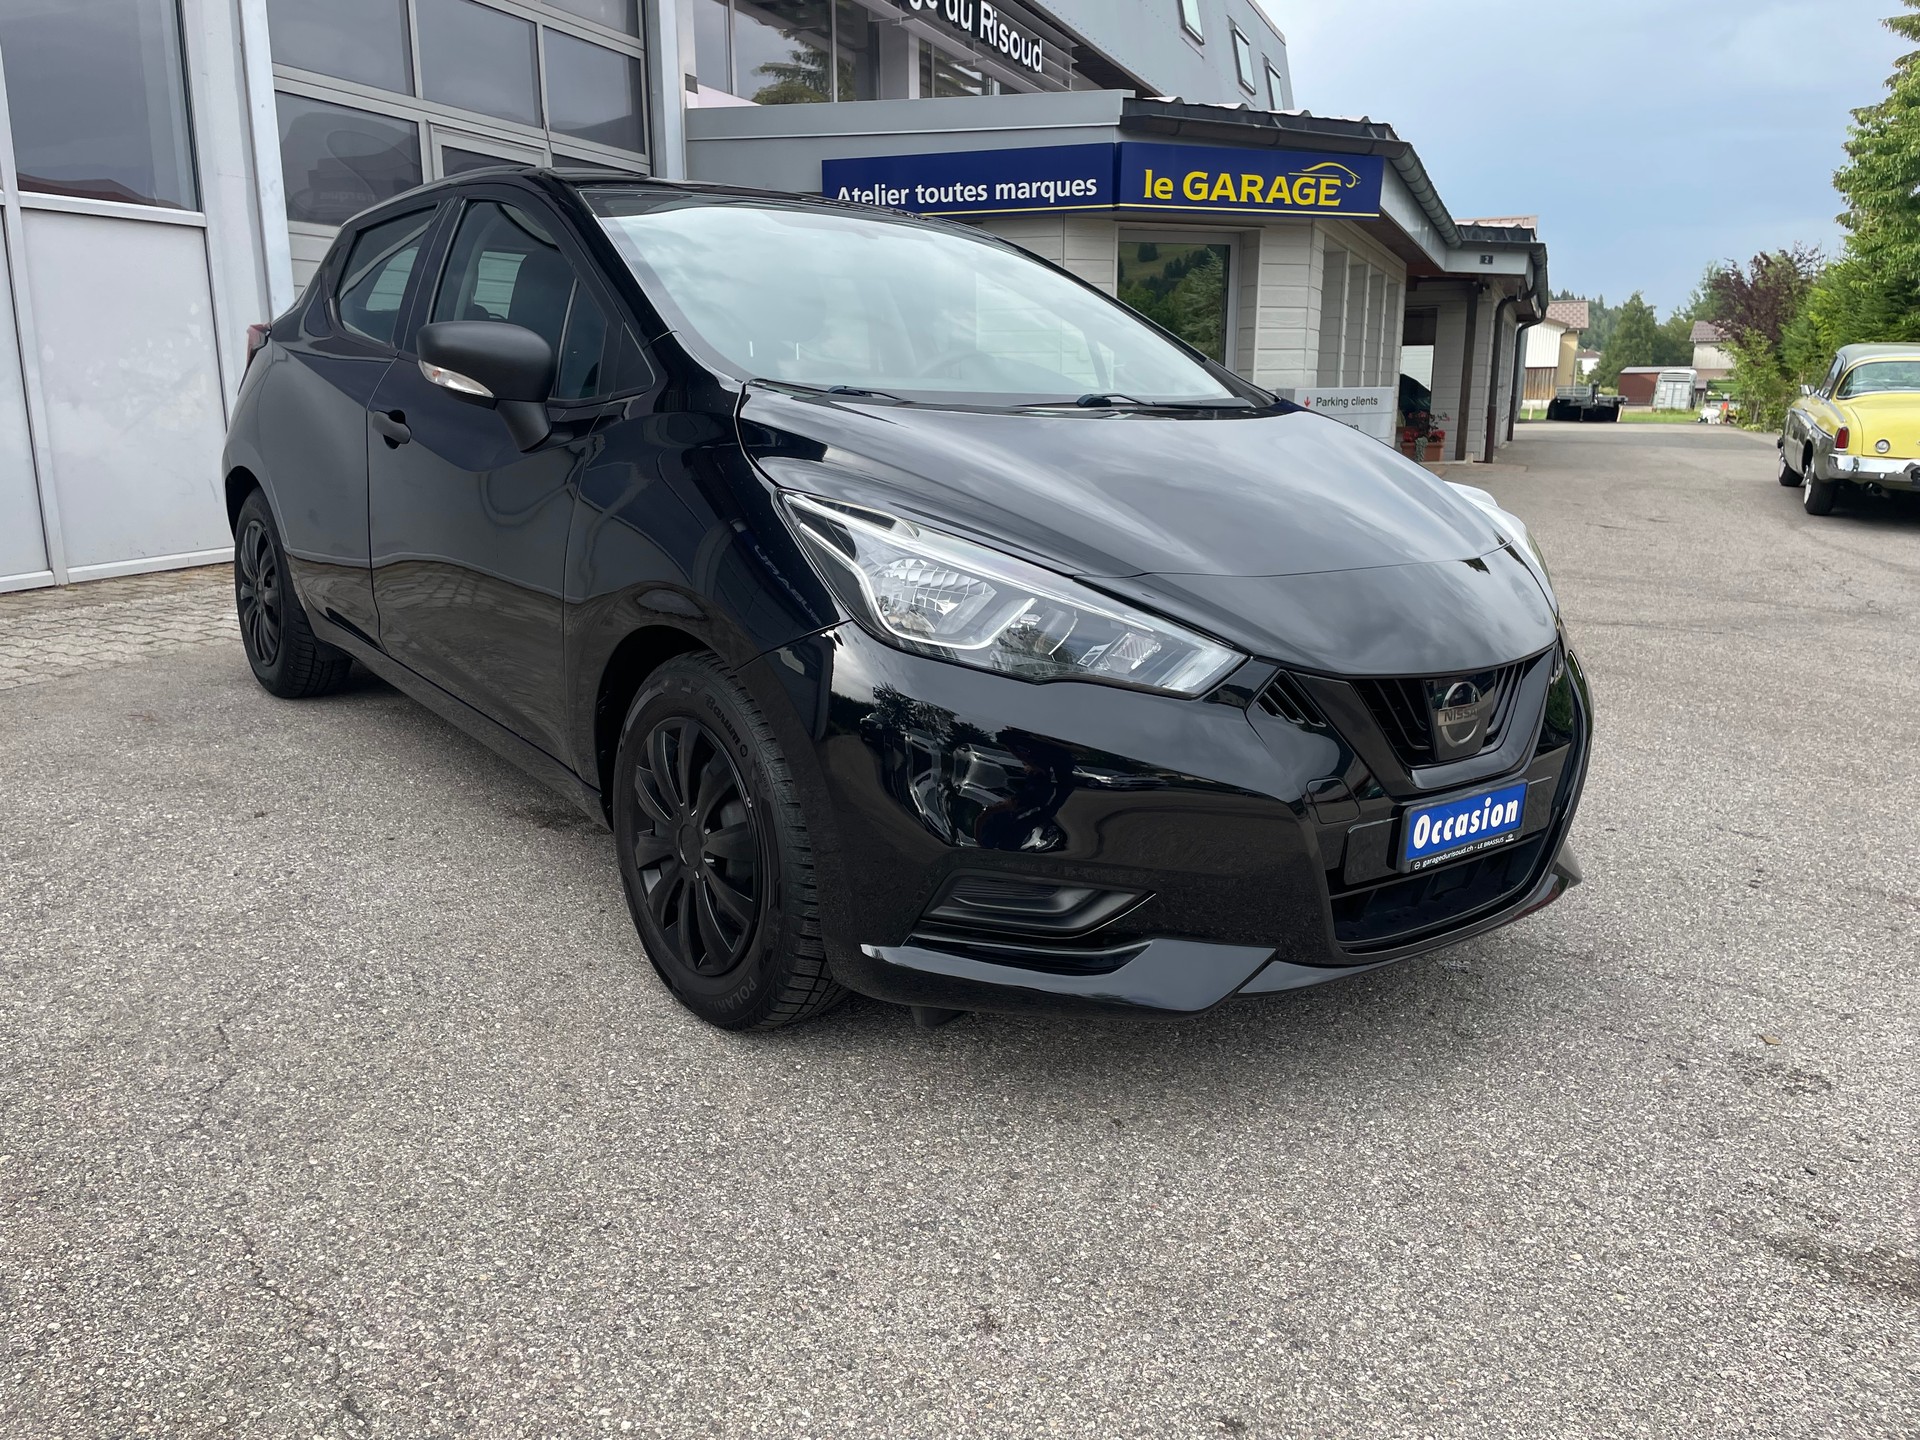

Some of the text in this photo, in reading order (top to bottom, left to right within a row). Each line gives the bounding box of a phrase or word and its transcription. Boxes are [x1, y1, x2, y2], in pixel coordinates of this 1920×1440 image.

[945, 0, 1043, 74] du Risoud
[838, 178, 1097, 206] Atelier toutes marques
[1144, 168, 1342, 207] le GARAGE
[1316, 396, 1378, 408] Parking clients
[1413, 797, 1519, 850] Occasion
[1422, 845, 1474, 869] garagedurisoud.ch
